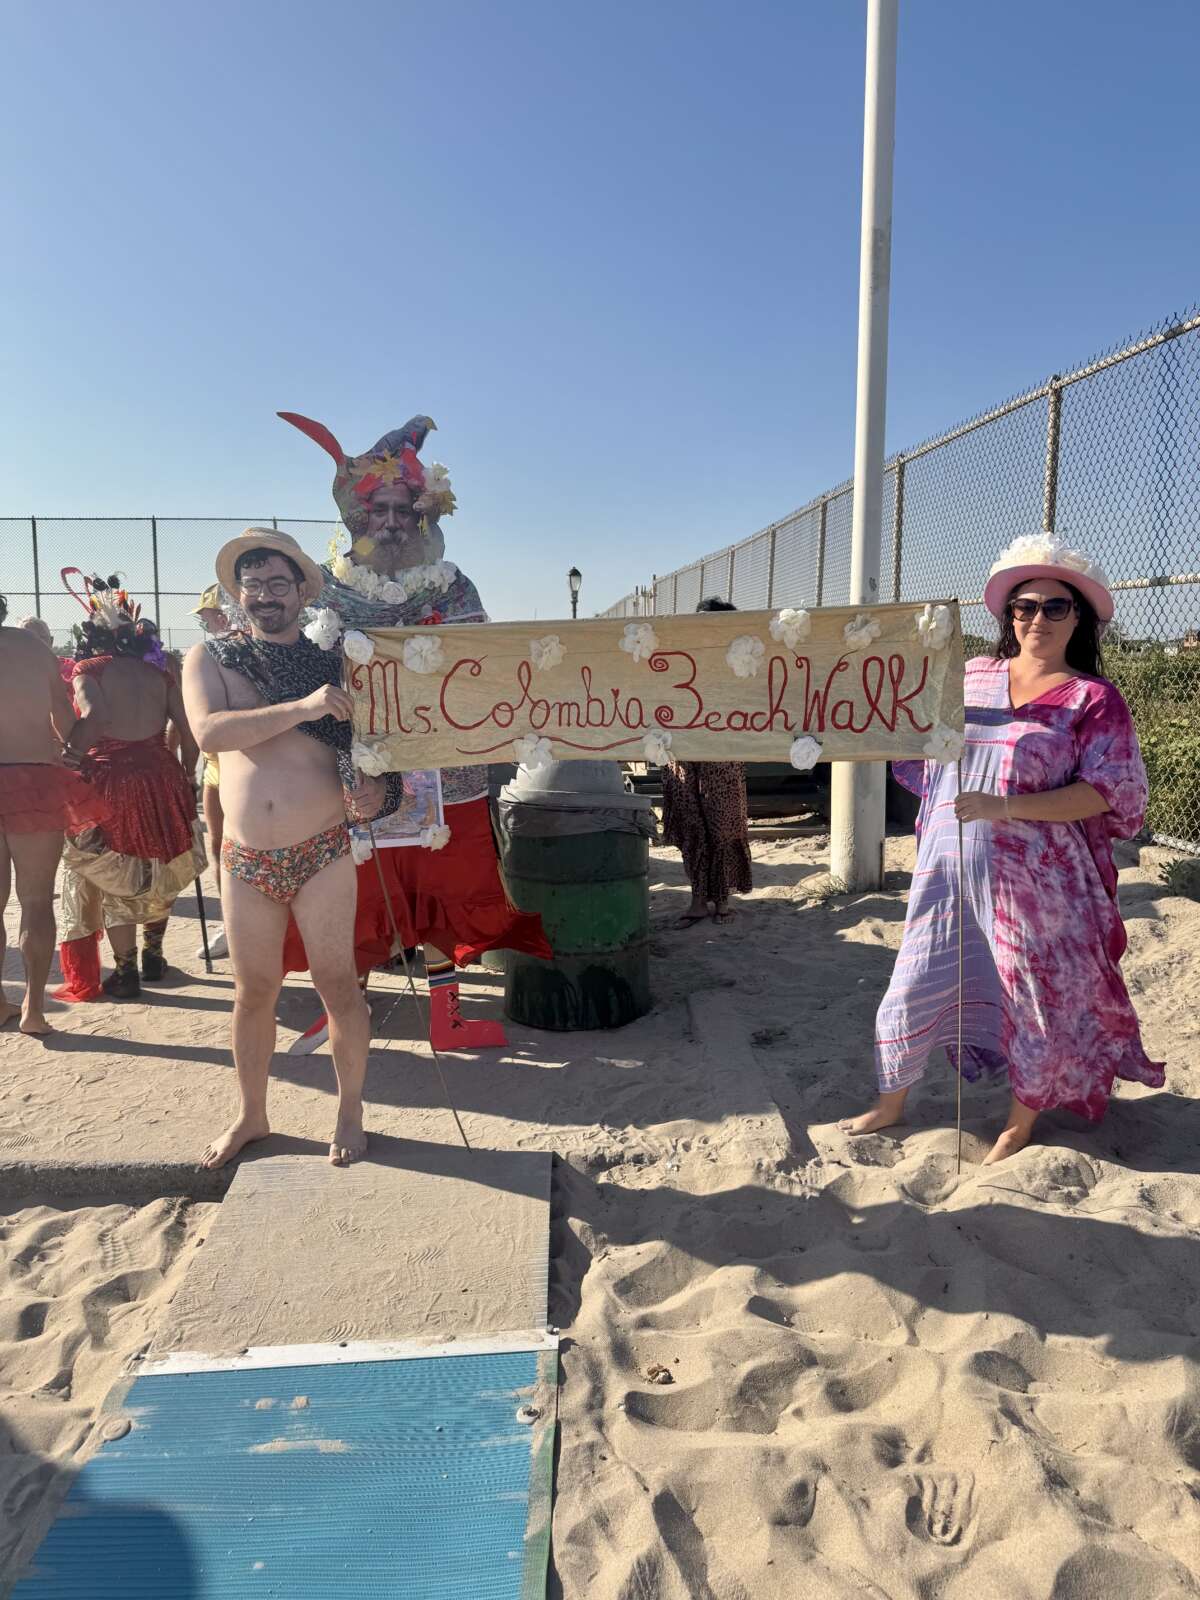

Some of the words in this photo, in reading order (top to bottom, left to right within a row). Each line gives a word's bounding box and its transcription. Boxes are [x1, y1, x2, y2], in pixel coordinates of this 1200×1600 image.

[351, 660, 438, 735] Ms.
[440, 655, 649, 730] Colombia
[648, 651, 796, 732] Beach
[793, 650, 934, 733] Walk
